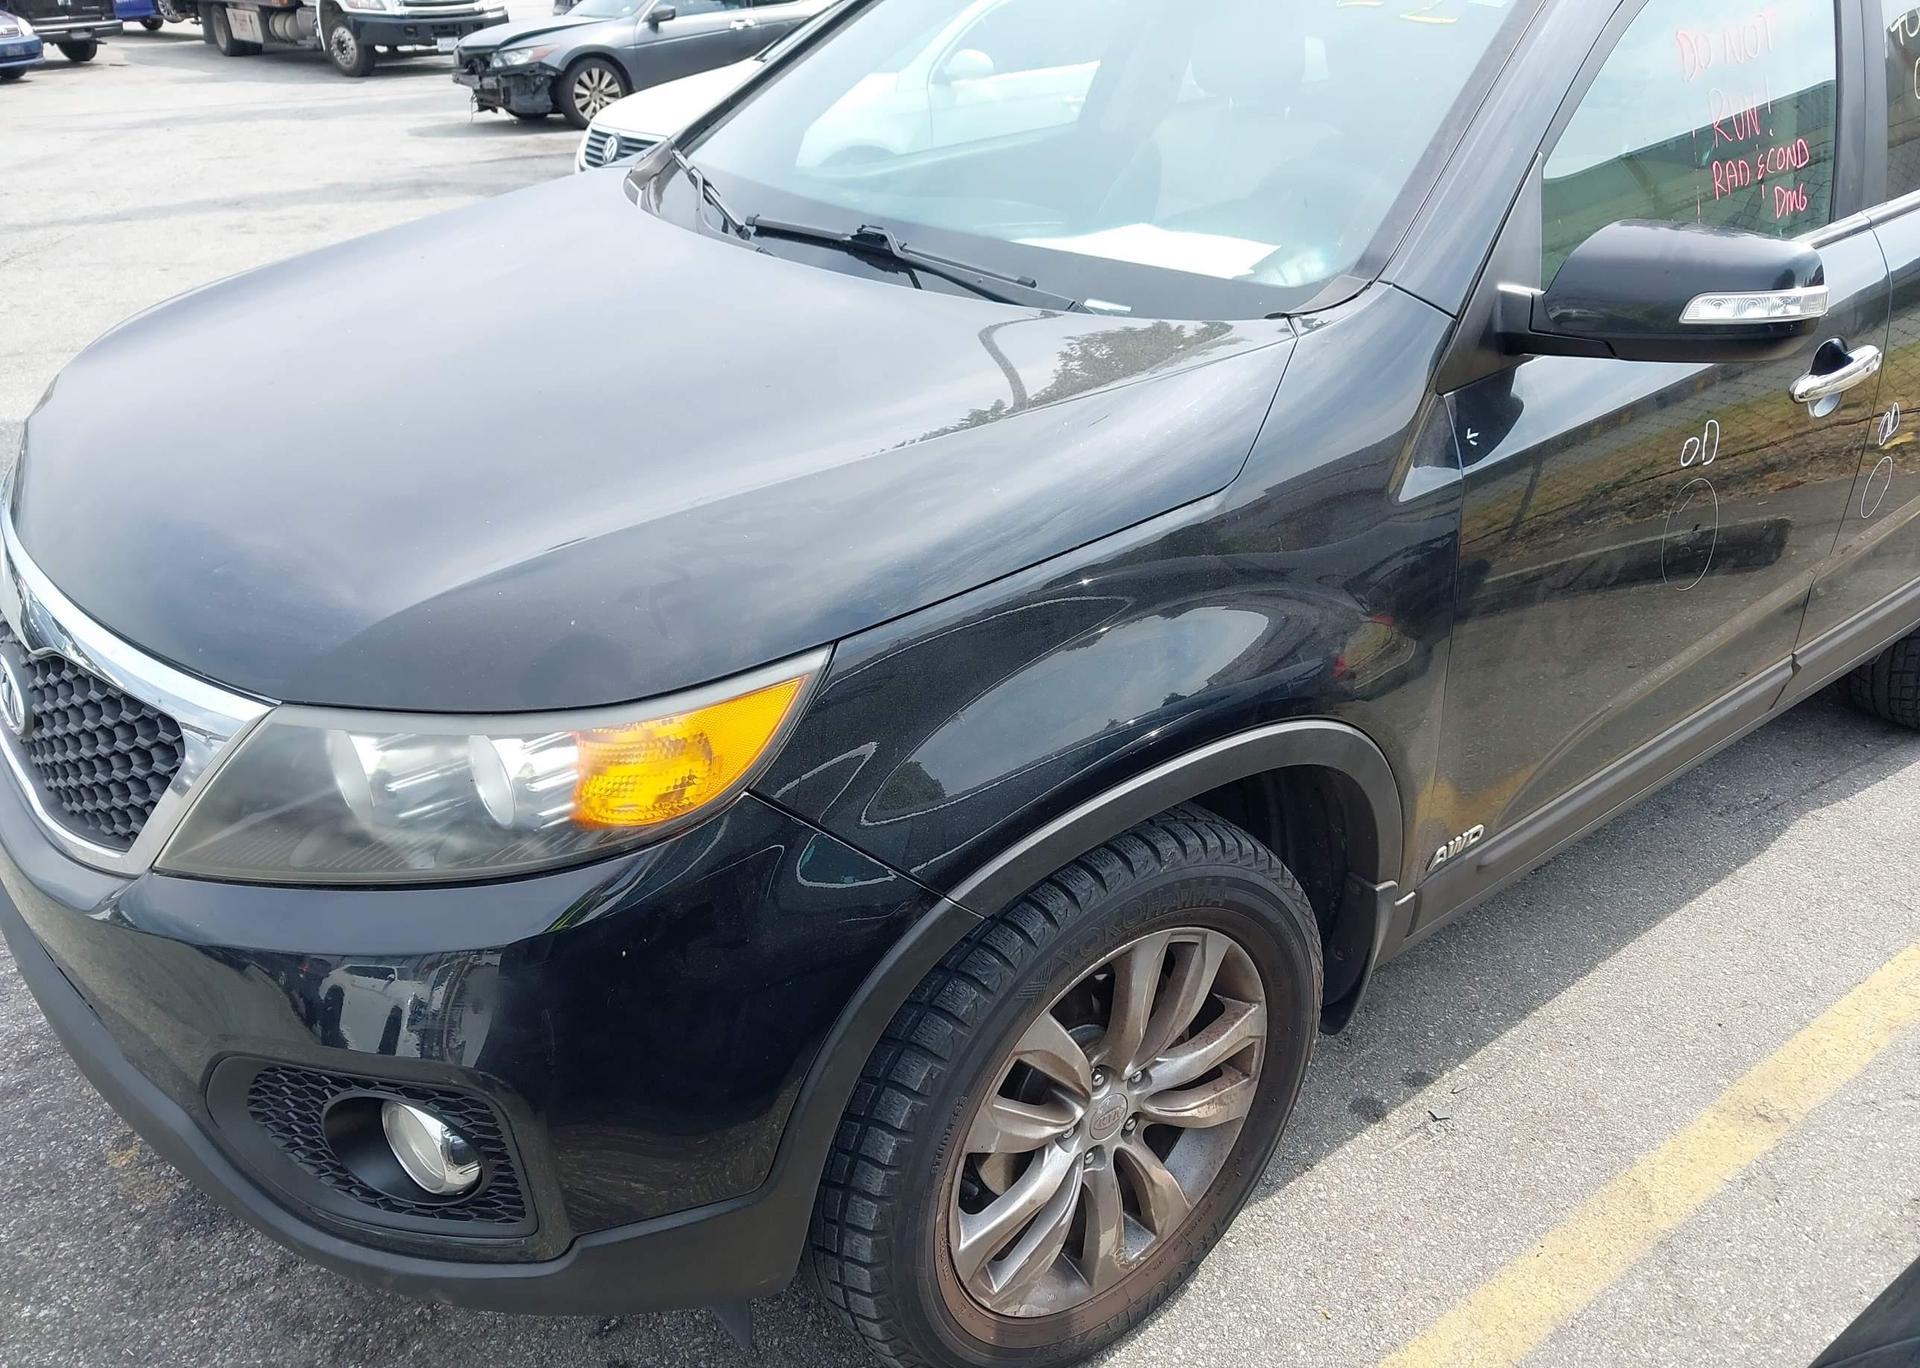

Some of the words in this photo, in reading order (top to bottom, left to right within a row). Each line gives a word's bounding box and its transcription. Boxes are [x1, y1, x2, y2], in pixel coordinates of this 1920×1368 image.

[1676, 31, 1711, 81] DO
[1724, 13, 1777, 65] NOT
[1712, 160, 1750, 200] RAD
[1774, 186, 1808, 218] DMG
[1427, 824, 1484, 871] AWD
